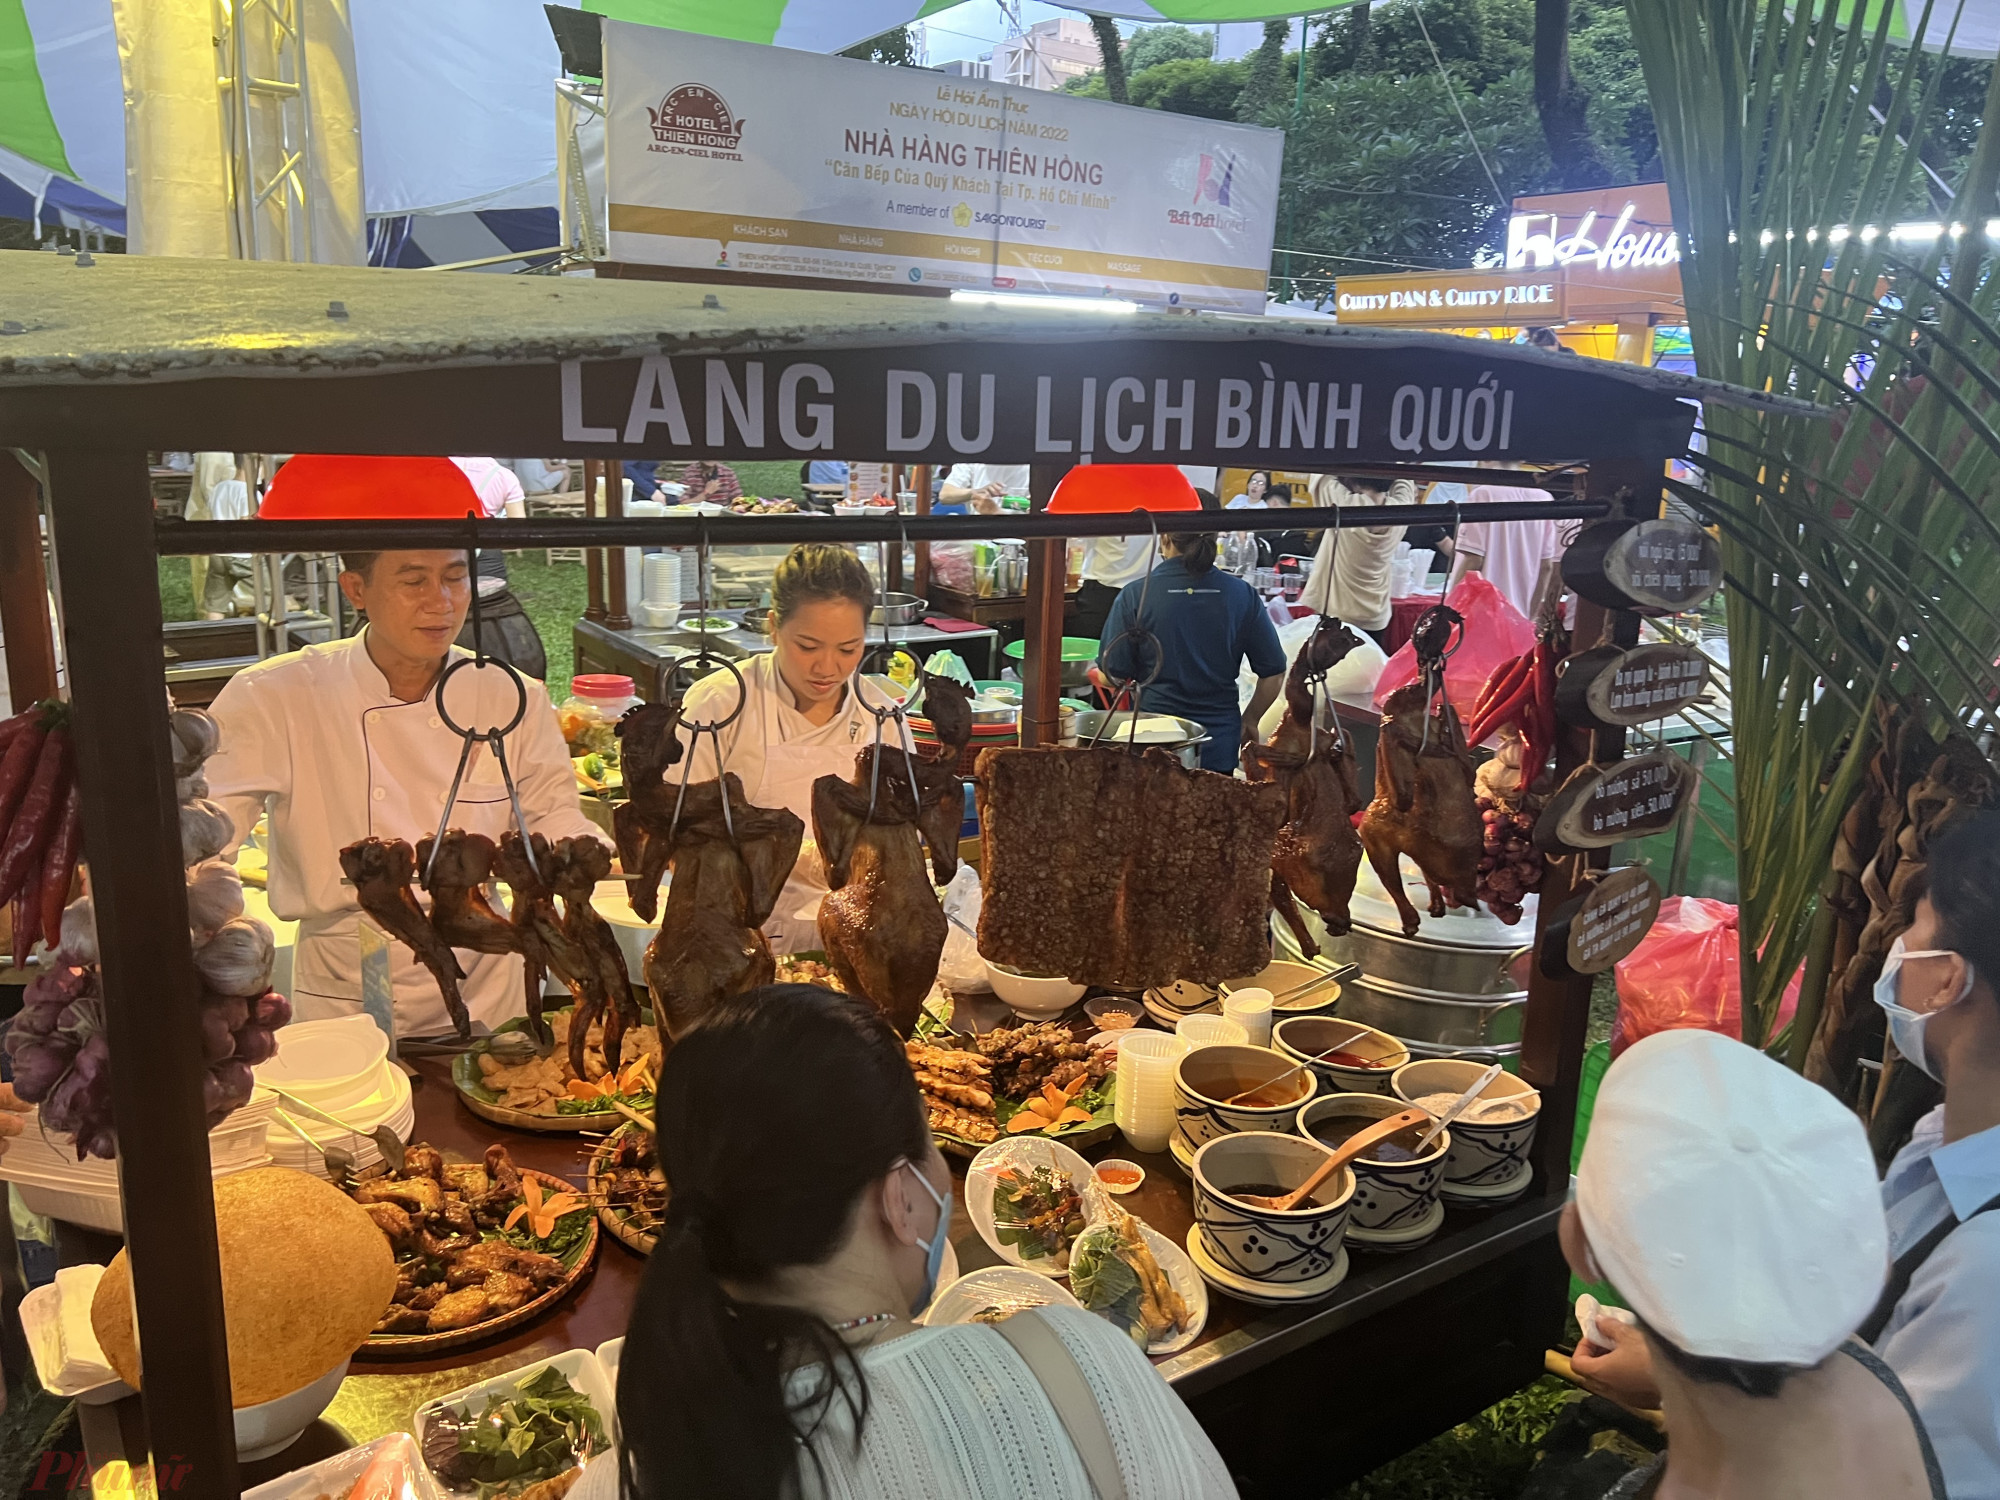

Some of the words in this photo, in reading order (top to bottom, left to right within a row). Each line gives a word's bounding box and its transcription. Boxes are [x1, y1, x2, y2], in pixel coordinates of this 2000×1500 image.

[687, 88, 704, 98] EN
[675, 115, 718, 131] HOTEL
[957, 112, 976, 128] DU
[1040, 125, 1069, 142] 2022
[655, 128, 695, 144] THIEN
[697, 133, 737, 148] HONG
[646, 143, 710, 158] ARC-EN-CIEL
[711, 150, 744, 162] HOTEL
[844, 127, 894, 158] NHÀ
[902, 133, 967, 167] HÀNG
[974, 146, 1037, 177] THIÊN
[1043, 153, 1104, 186] HỒNG
[952, 174, 991, 194] Khách
[886, 199, 895, 214] A
[897, 202, 938, 219] member
[940, 205, 950, 220] of
[974, 211, 1047, 230] SAIGONTOURIST
[1107, 261, 1142, 273] MASSAGE
[1339, 291, 1389, 312] Curry
[1390, 289, 1427, 310] PAN
[1428, 287, 1443, 308] &
[1444, 287, 1502, 309] Curry
[1503, 284, 1554, 305] RICE
[886, 369, 996, 455] DU
[1034, 375, 1196, 465] LỊCH
[1215, 361, 1363, 450] BÌNH
[1388, 371, 1514, 455] QUỚI
